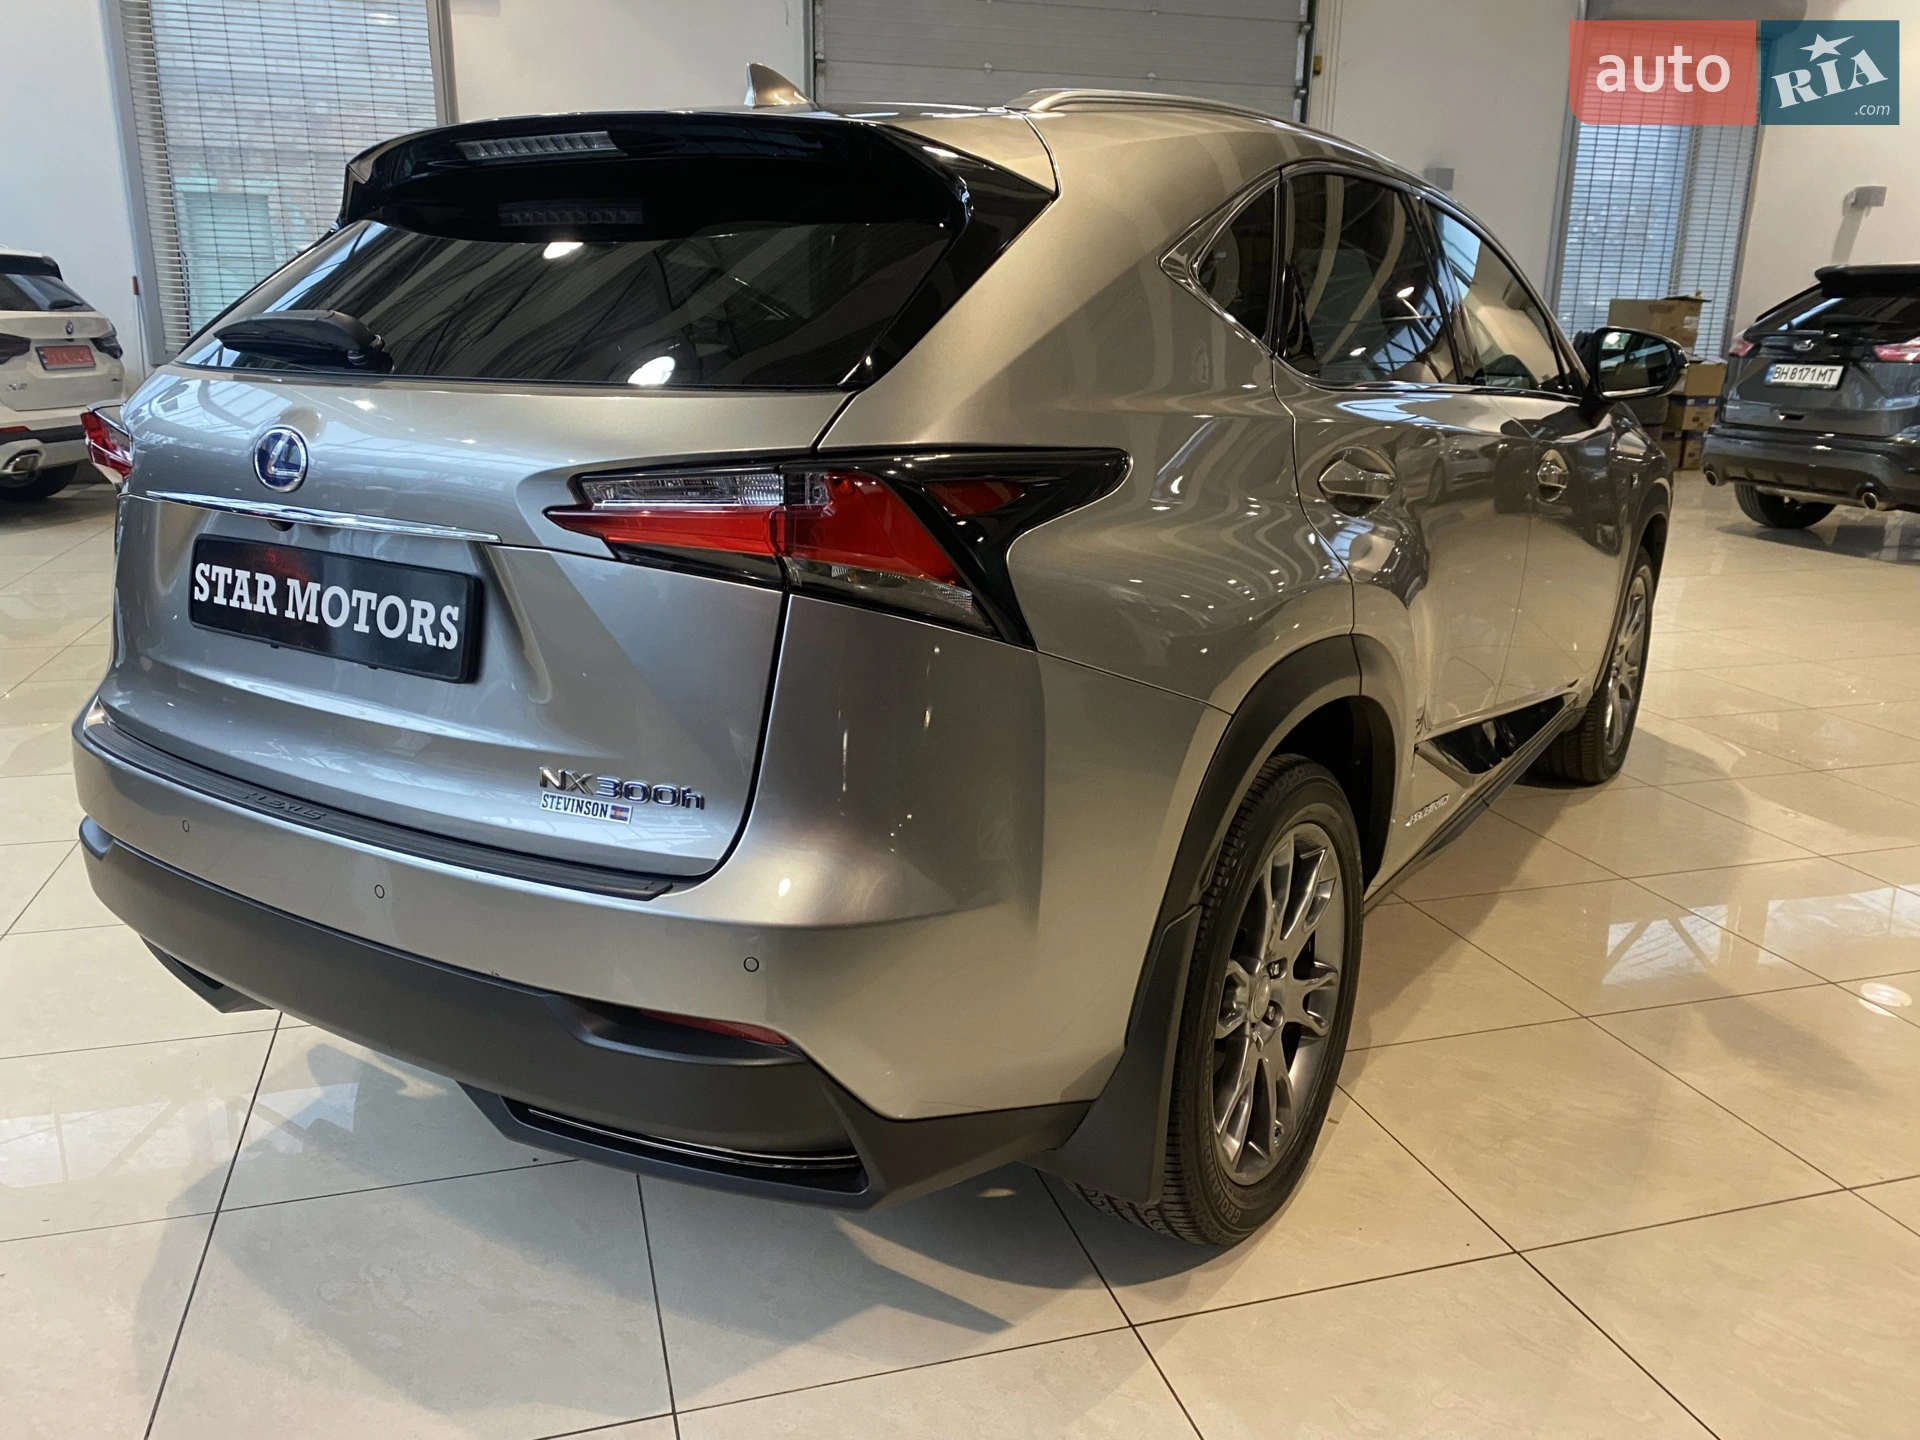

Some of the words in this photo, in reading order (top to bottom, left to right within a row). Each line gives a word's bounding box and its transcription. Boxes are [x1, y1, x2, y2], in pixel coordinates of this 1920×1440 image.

[1773, 367, 1790, 380] BH
[1790, 367, 1817, 381] 8171
[1817, 368, 1837, 382] MT
[194, 562, 277, 615] STAR
[284, 578, 459, 650] MOTORS
[539, 766, 593, 795] NX
[596, 775, 705, 809] 300h
[255, 795, 327, 820] LEXUS
[541, 795, 609, 819] STEVINSON
